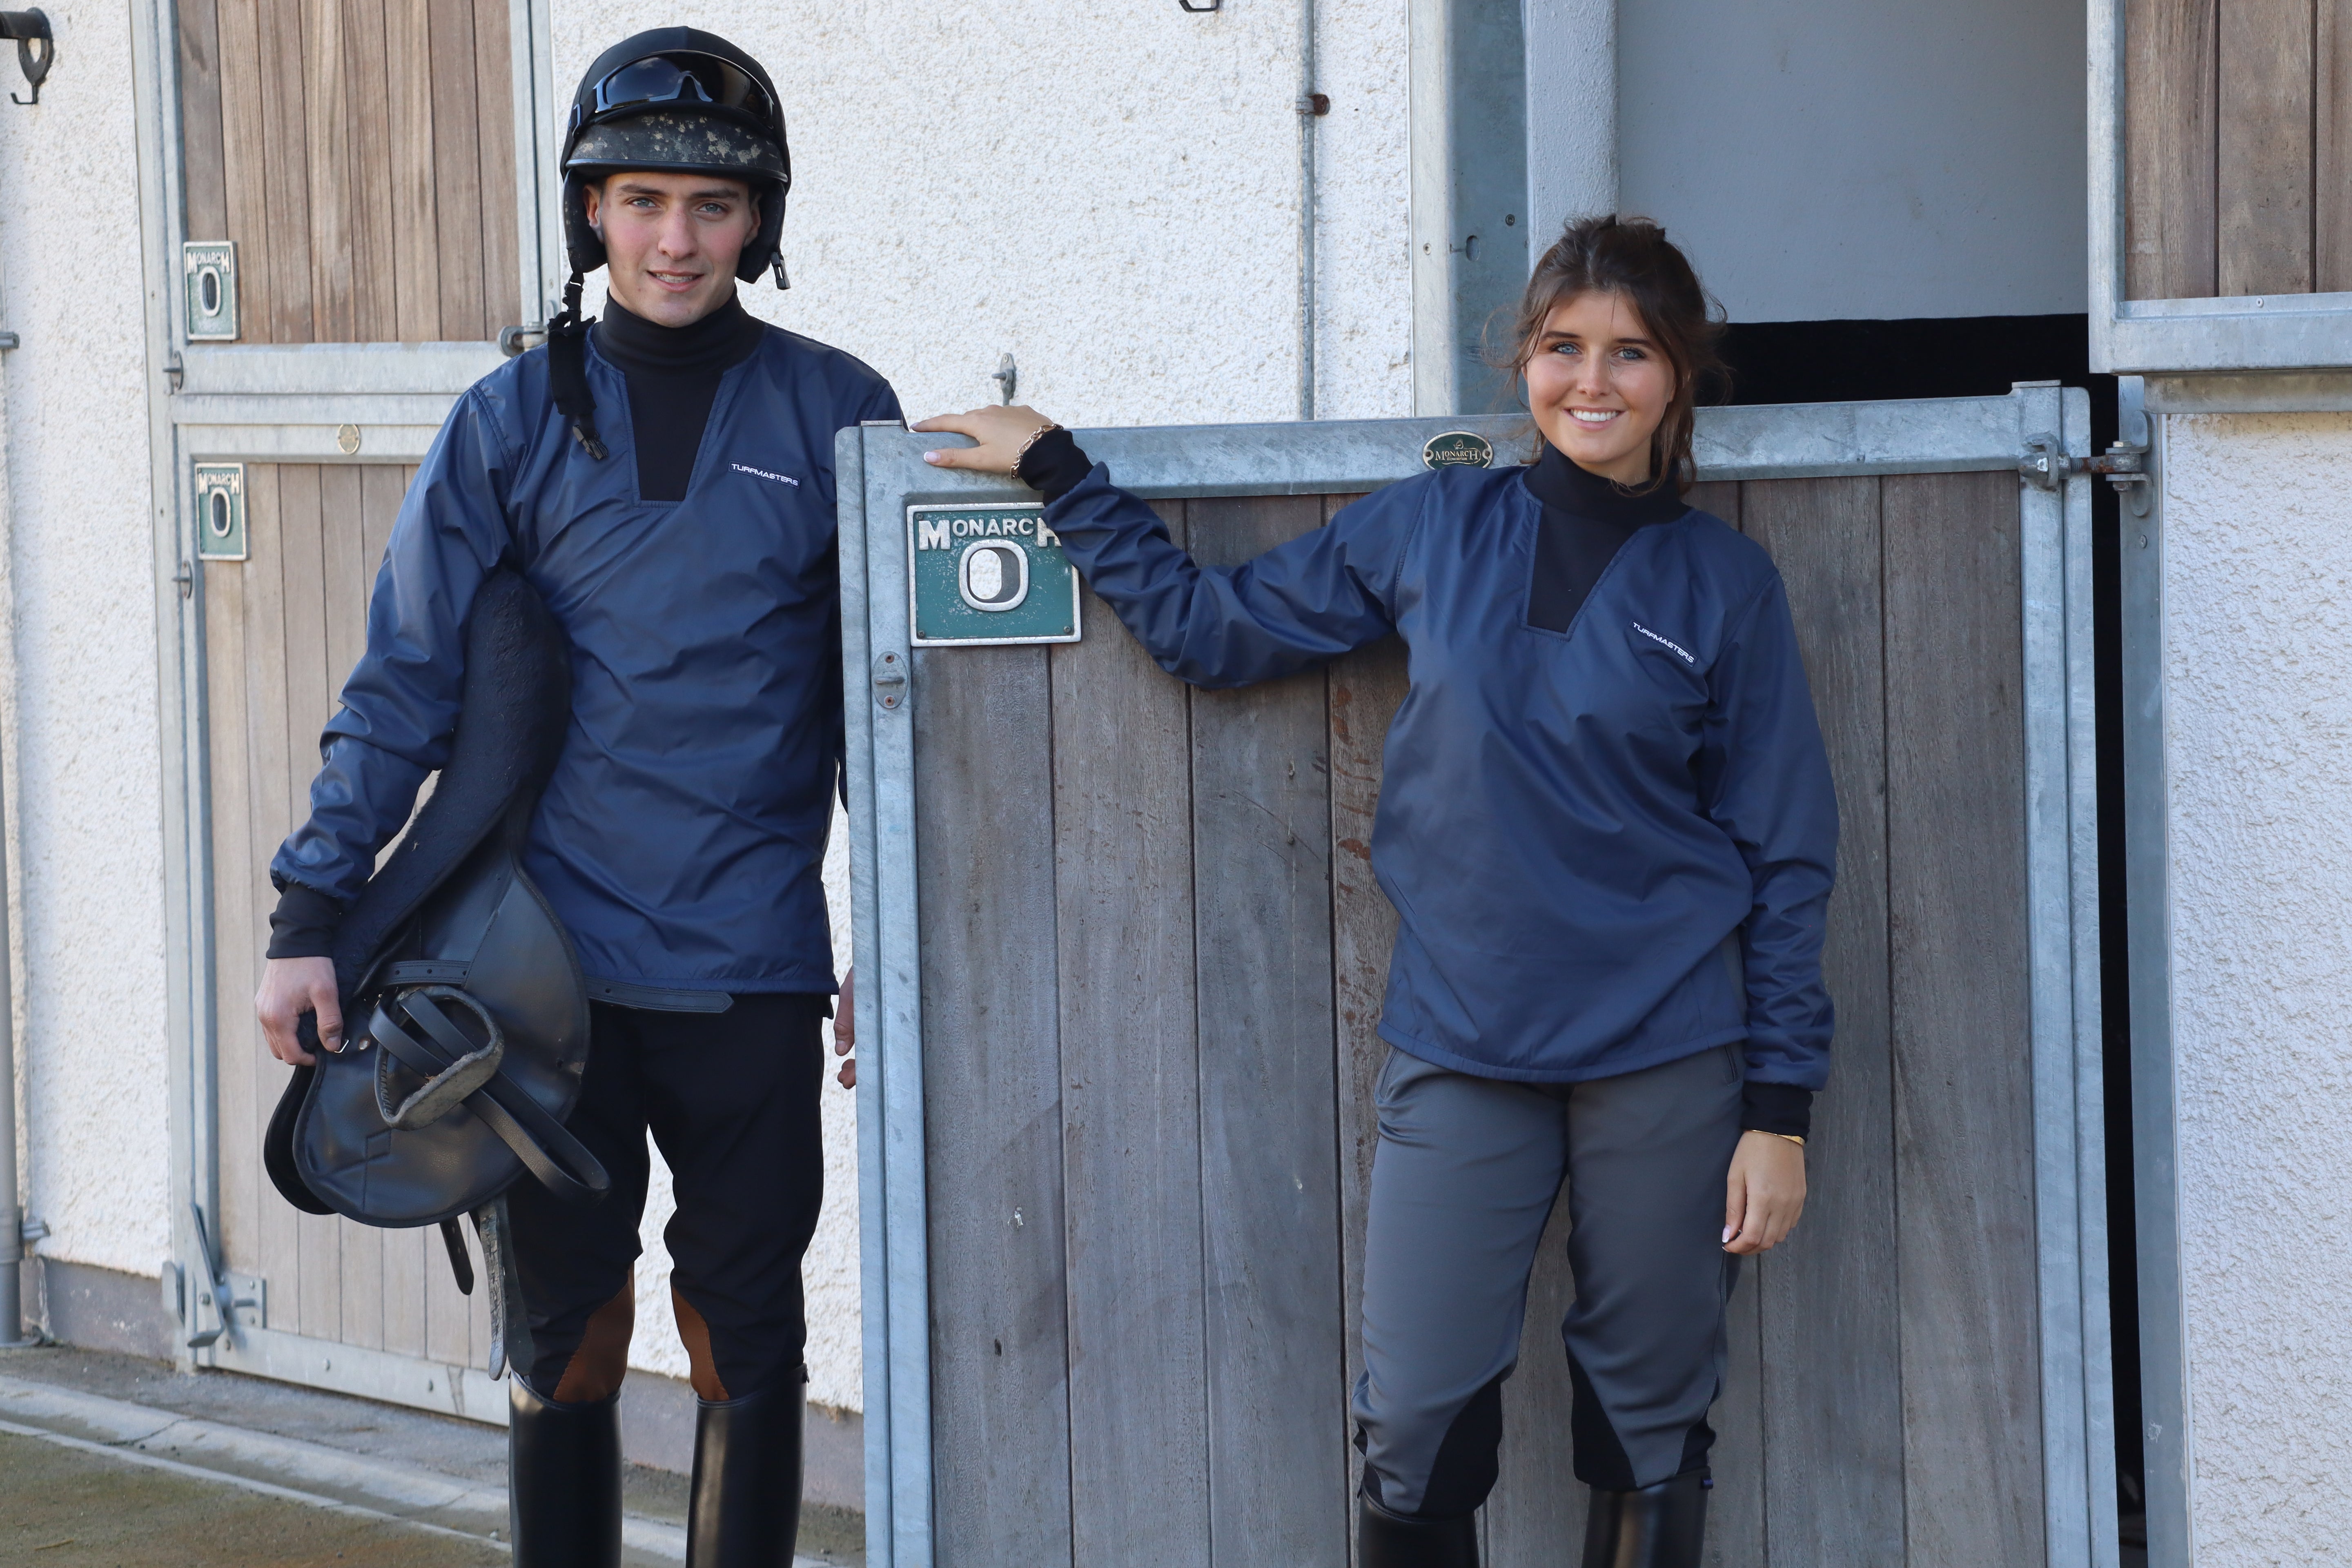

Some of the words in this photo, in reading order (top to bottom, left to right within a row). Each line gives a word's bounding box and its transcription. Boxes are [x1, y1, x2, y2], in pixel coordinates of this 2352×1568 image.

[187, 252, 229, 273] MONARCH
[1435, 450, 1478, 461] MONARCH
[199, 473, 239, 494] MONARCH
[731, 463, 798, 486] TURFMASTERS
[1633, 622, 1694, 663] TURFMASTERS
